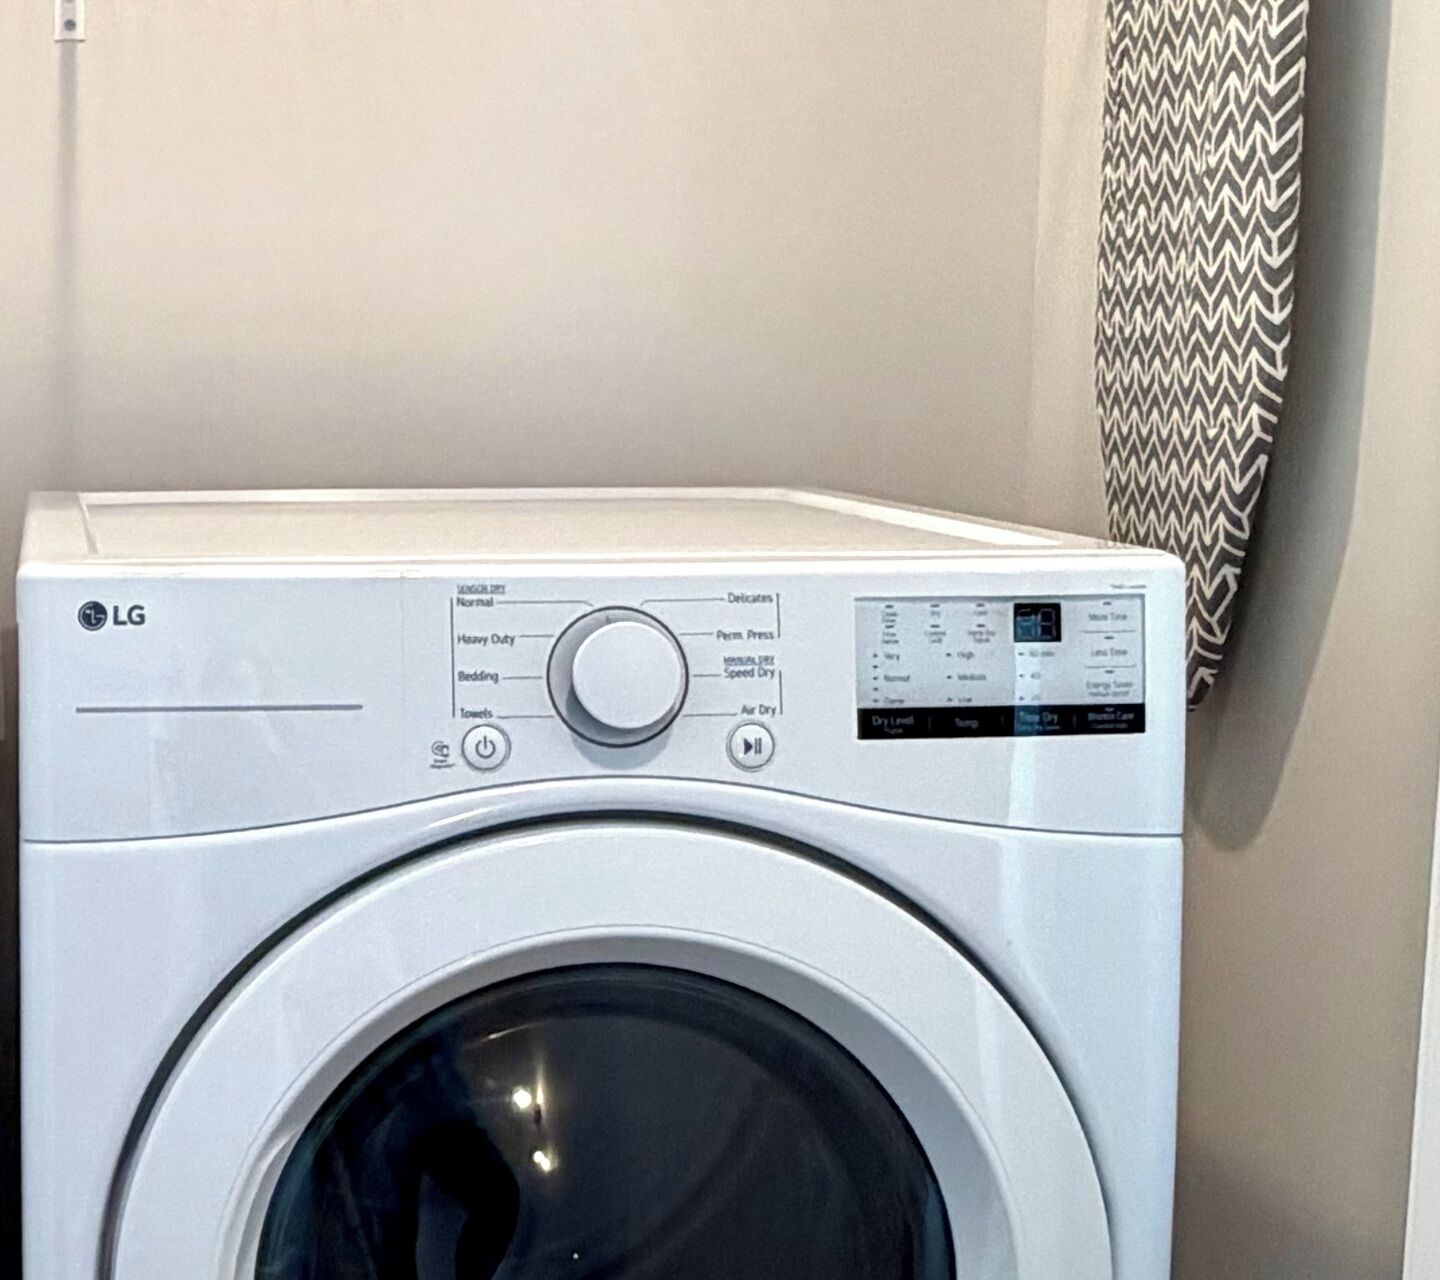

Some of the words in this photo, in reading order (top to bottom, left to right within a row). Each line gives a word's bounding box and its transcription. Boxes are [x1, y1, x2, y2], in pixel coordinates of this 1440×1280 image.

[456, 597, 494, 607] Normal
[728, 592, 773, 603] Delicates
[113, 604, 146, 626] LG
[458, 634, 487, 646] Heavy
[491, 634, 515, 646] Duty
[747, 630, 774, 640] Press
[458, 671, 499, 683] Bedding
[724, 668, 755, 679] Speed
[757, 668, 775, 680] Dry
[460, 708, 492, 718] Towels
[741, 705, 755, 715] Air
[758, 704, 777, 717] Dry
